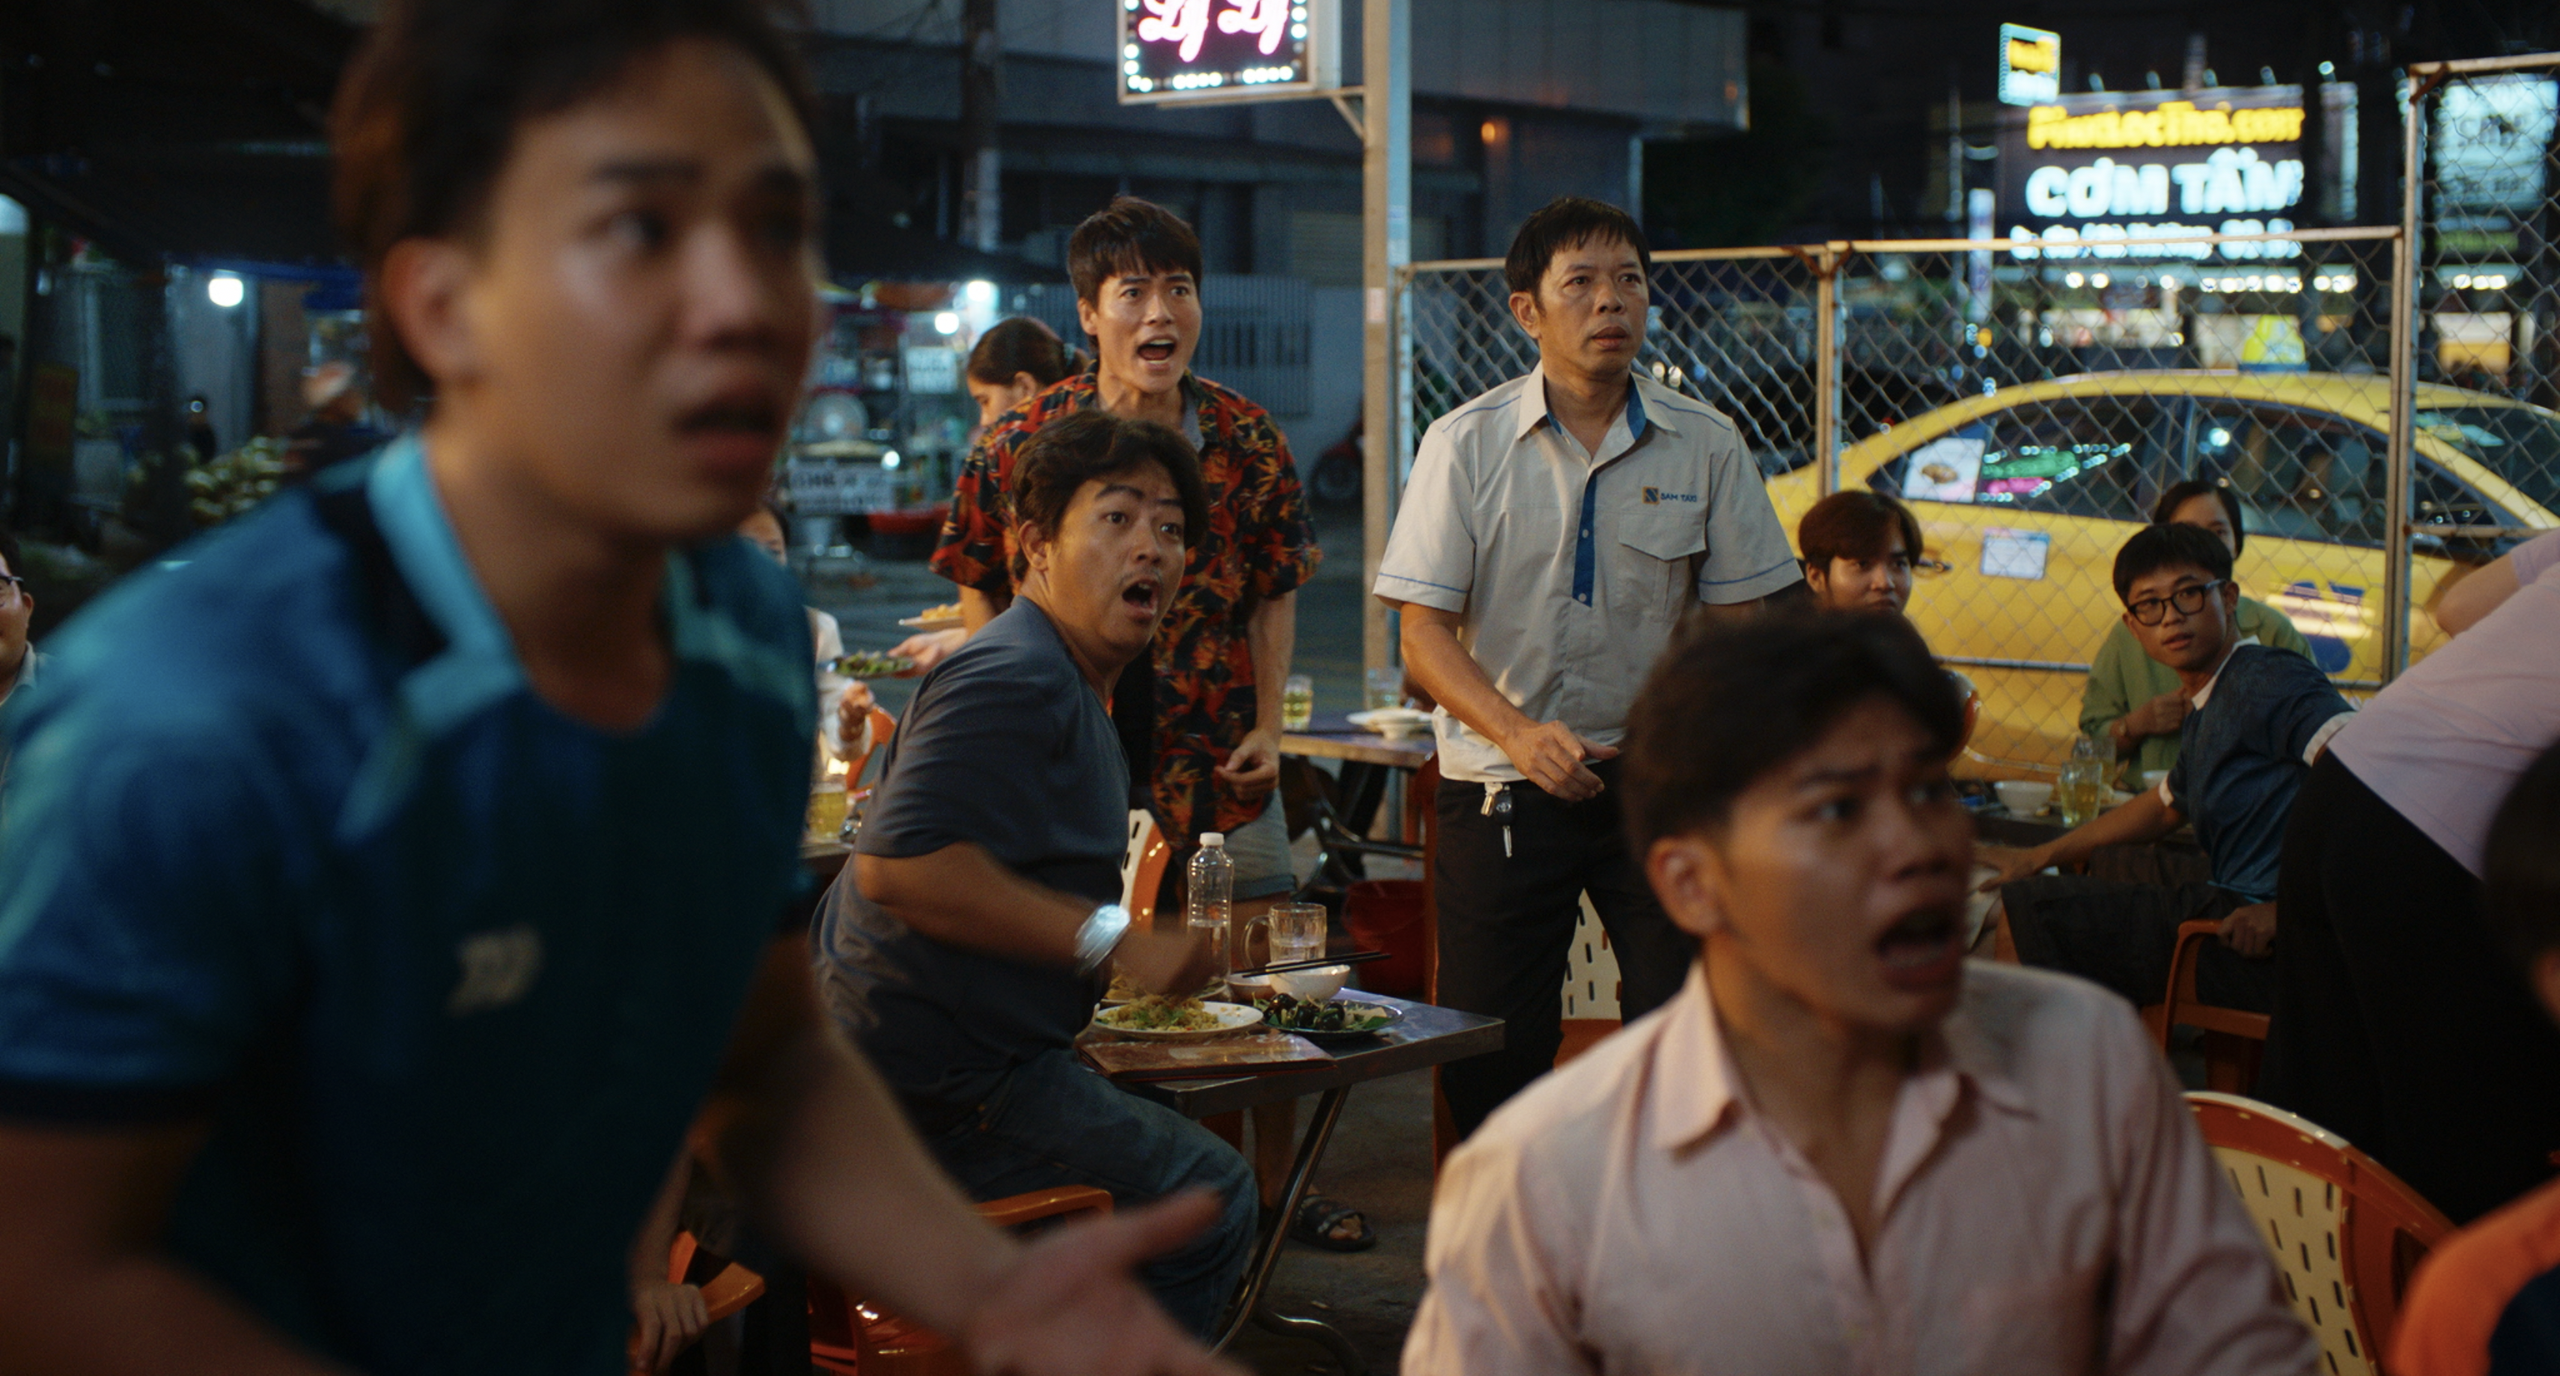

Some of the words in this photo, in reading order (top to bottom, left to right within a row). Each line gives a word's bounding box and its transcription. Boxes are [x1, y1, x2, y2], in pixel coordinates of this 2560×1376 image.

[2026, 157, 2169, 217] CƠM
[2172, 147, 2304, 214] TẤM
[1660, 492, 1679, 501] SAM
[1680, 493, 1698, 503] TAXI
